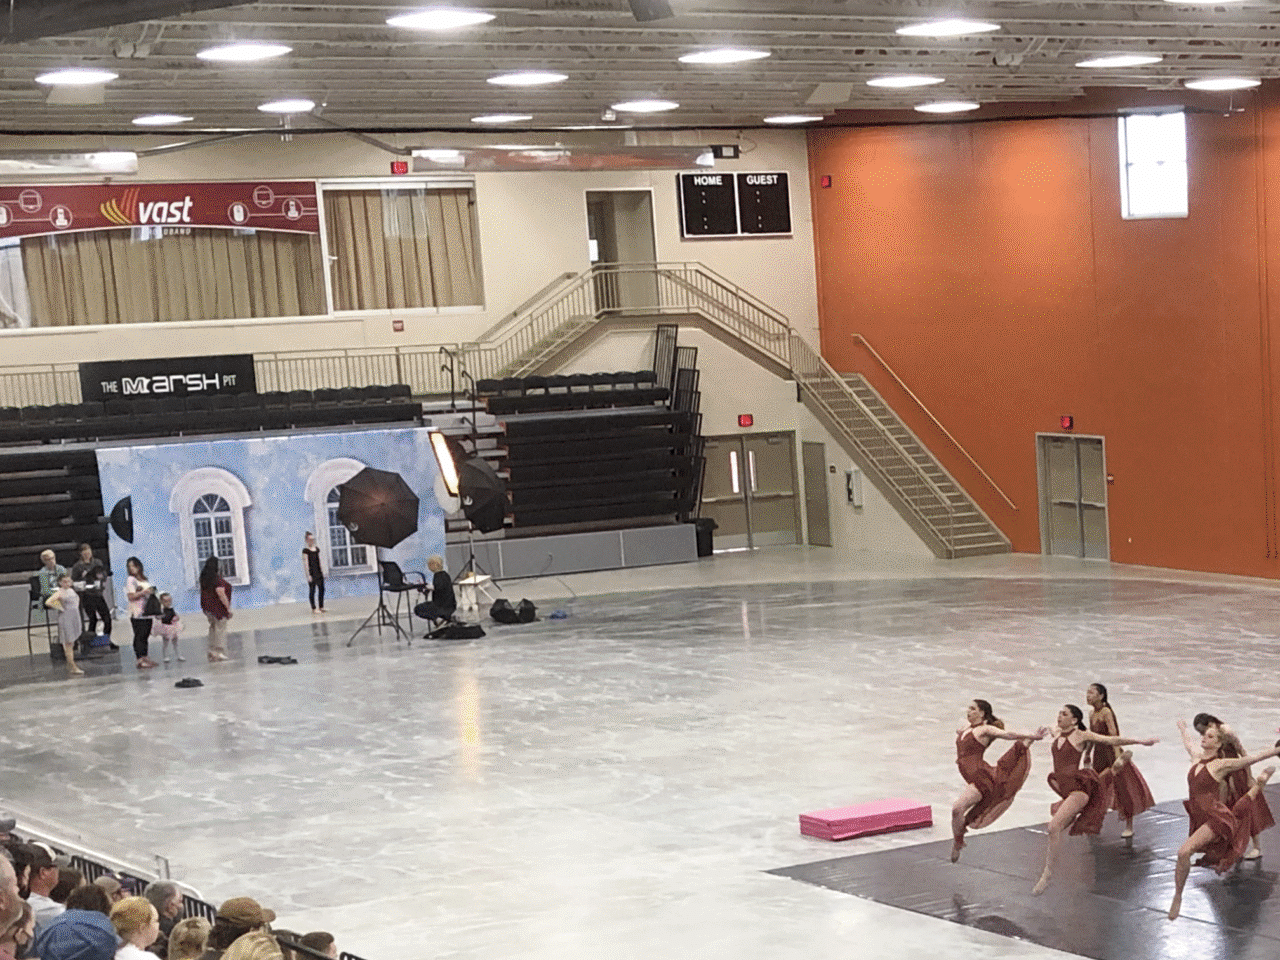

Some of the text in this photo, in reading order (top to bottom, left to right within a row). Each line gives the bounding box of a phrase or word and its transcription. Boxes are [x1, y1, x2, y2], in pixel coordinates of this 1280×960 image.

[694, 176, 723, 186] HOME
[746, 175, 778, 185] GUEST
[139, 195, 193, 224] vast
[101, 381, 118, 393] THE
[222, 374, 237, 387] PIT
